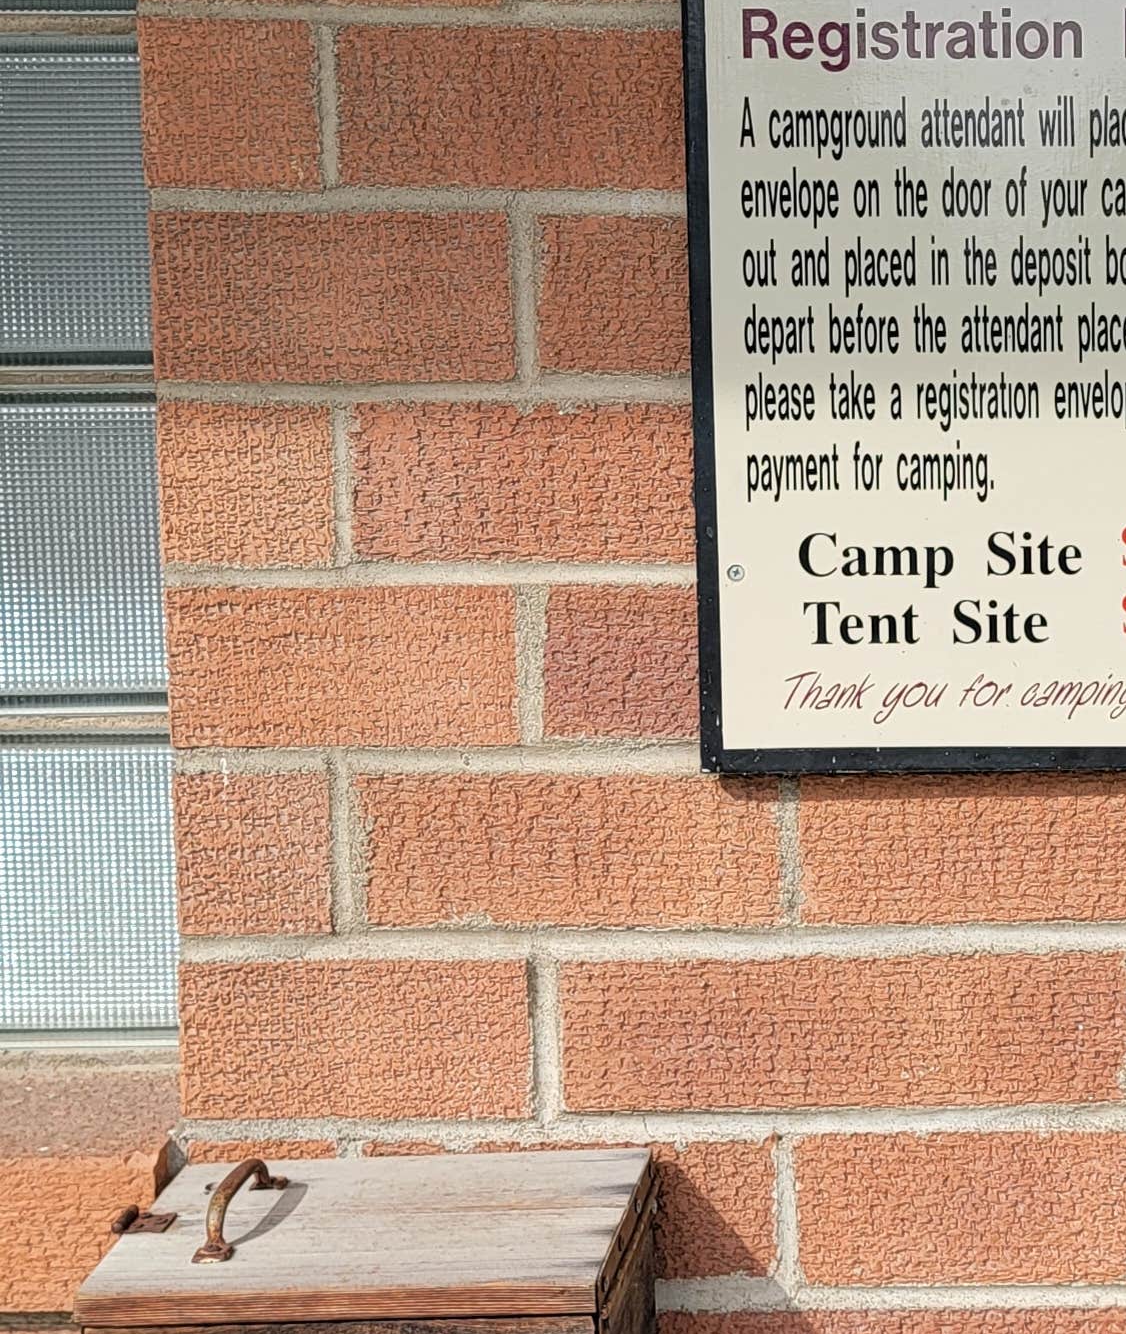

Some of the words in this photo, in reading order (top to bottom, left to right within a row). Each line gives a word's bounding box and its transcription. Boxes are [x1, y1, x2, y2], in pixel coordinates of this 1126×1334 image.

[741, 7, 1083, 73] Registration
[739, 95, 756, 148] A
[768, 95, 907, 162] campground
[920, 95, 1026, 149] attendant
[1038, 94, 1075, 148] will
[740, 165, 840, 230] envelope
[853, 178, 881, 219] on
[894, 165, 929, 219] the
[941, 165, 992, 218] door
[1005, 165, 1028, 218] of
[1040, 178, 1088, 229] your
[742, 238, 778, 288] out
[790, 235, 830, 288] and
[844, 235, 917, 299] placed
[930, 234, 950, 286] in
[963, 234, 998, 287] the
[1010, 234, 1092, 298] deposit
[743, 302, 816, 366] depart
[828, 302, 900, 355] before
[912, 302, 947, 355] the
[961, 301, 1064, 354] attendant
[744, 371, 816, 432] please
[828, 369, 876, 421] take
[890, 382, 903, 421] a
[916, 368, 1040, 433] registration
[746, 442, 840, 503] payment
[852, 440, 884, 492] for
[896, 439, 995, 504] camping.
[798, 532, 955, 589] Camp
[986, 530, 1083, 577] Site
[802, 601, 921, 646] Tent
[952, 599, 1050, 645] Site
[784, 672, 875, 710] Thank
[873, 682, 948, 724] you
[959, 674, 1012, 707] for
